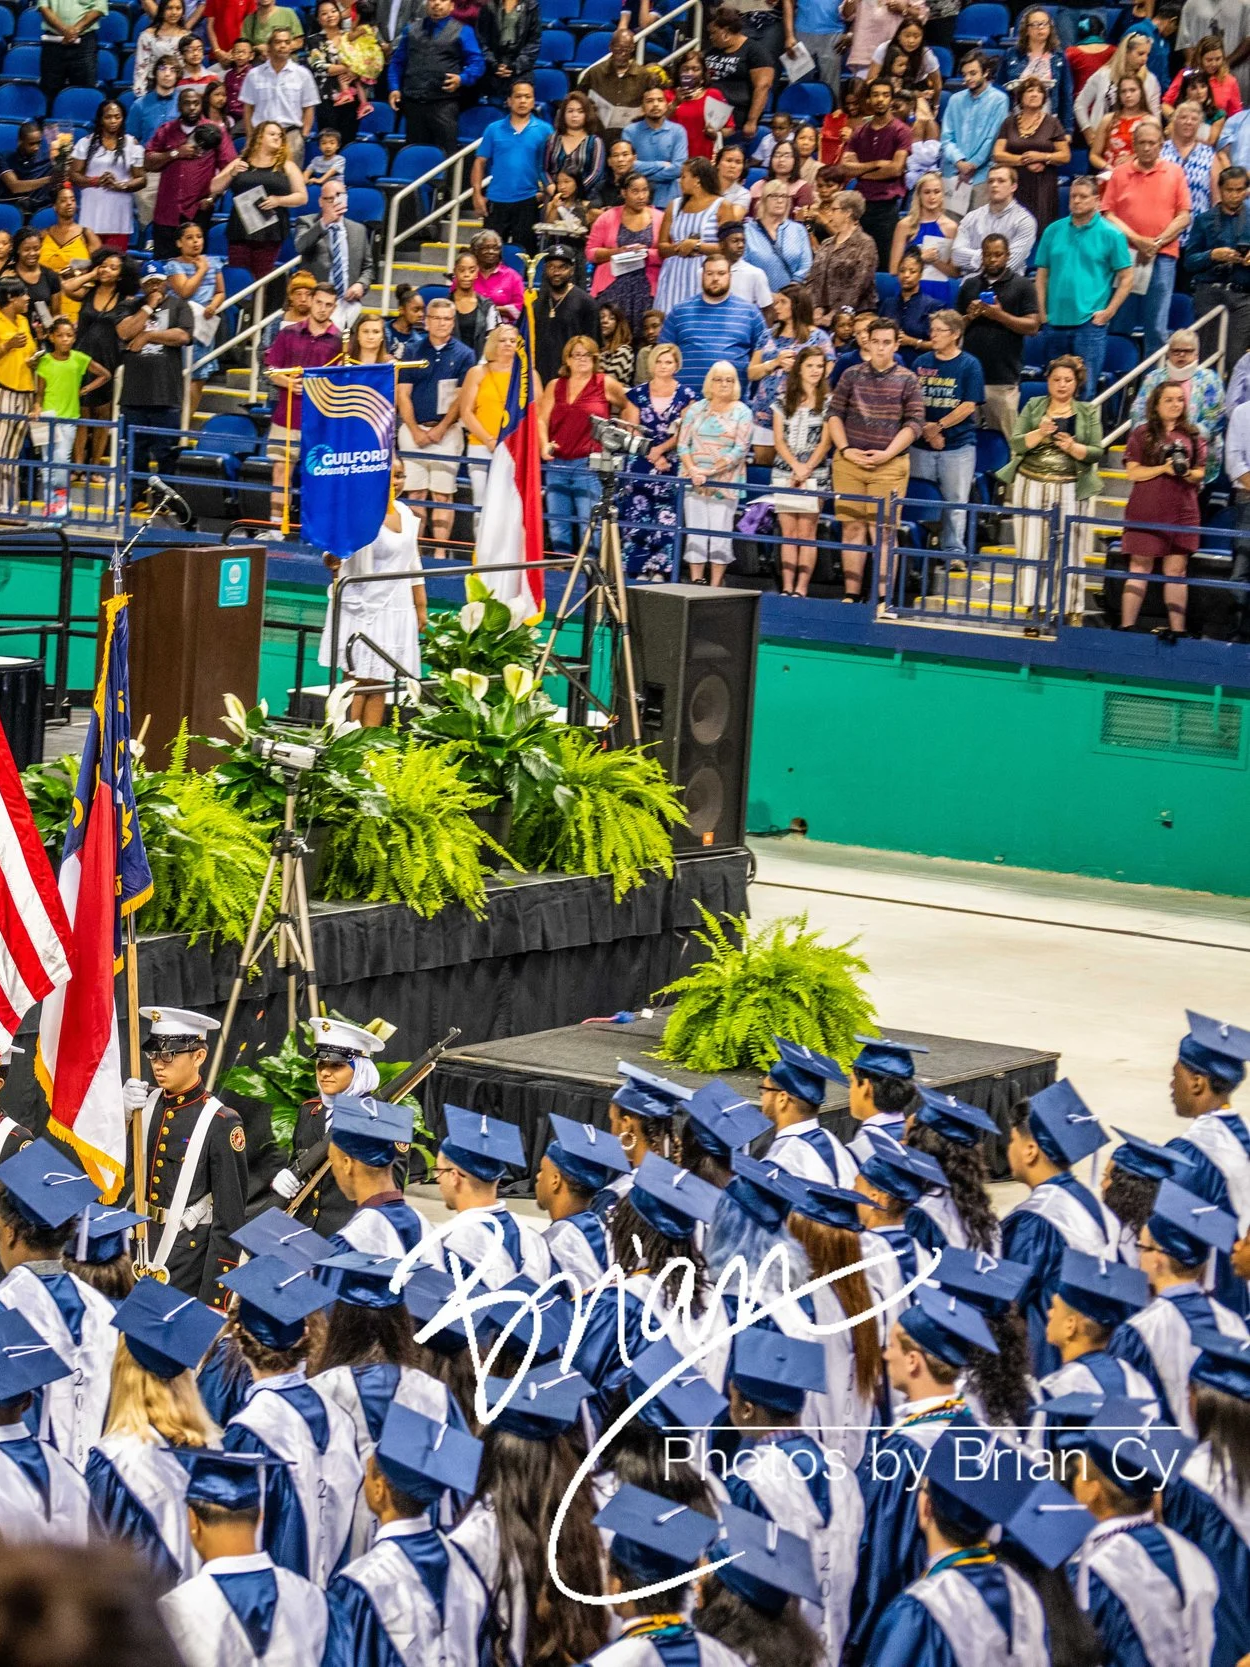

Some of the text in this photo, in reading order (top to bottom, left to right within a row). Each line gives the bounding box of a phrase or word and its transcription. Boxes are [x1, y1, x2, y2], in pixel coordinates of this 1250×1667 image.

[322, 449, 389, 465] GUILFORD
[313, 461, 389, 477] County Schools
